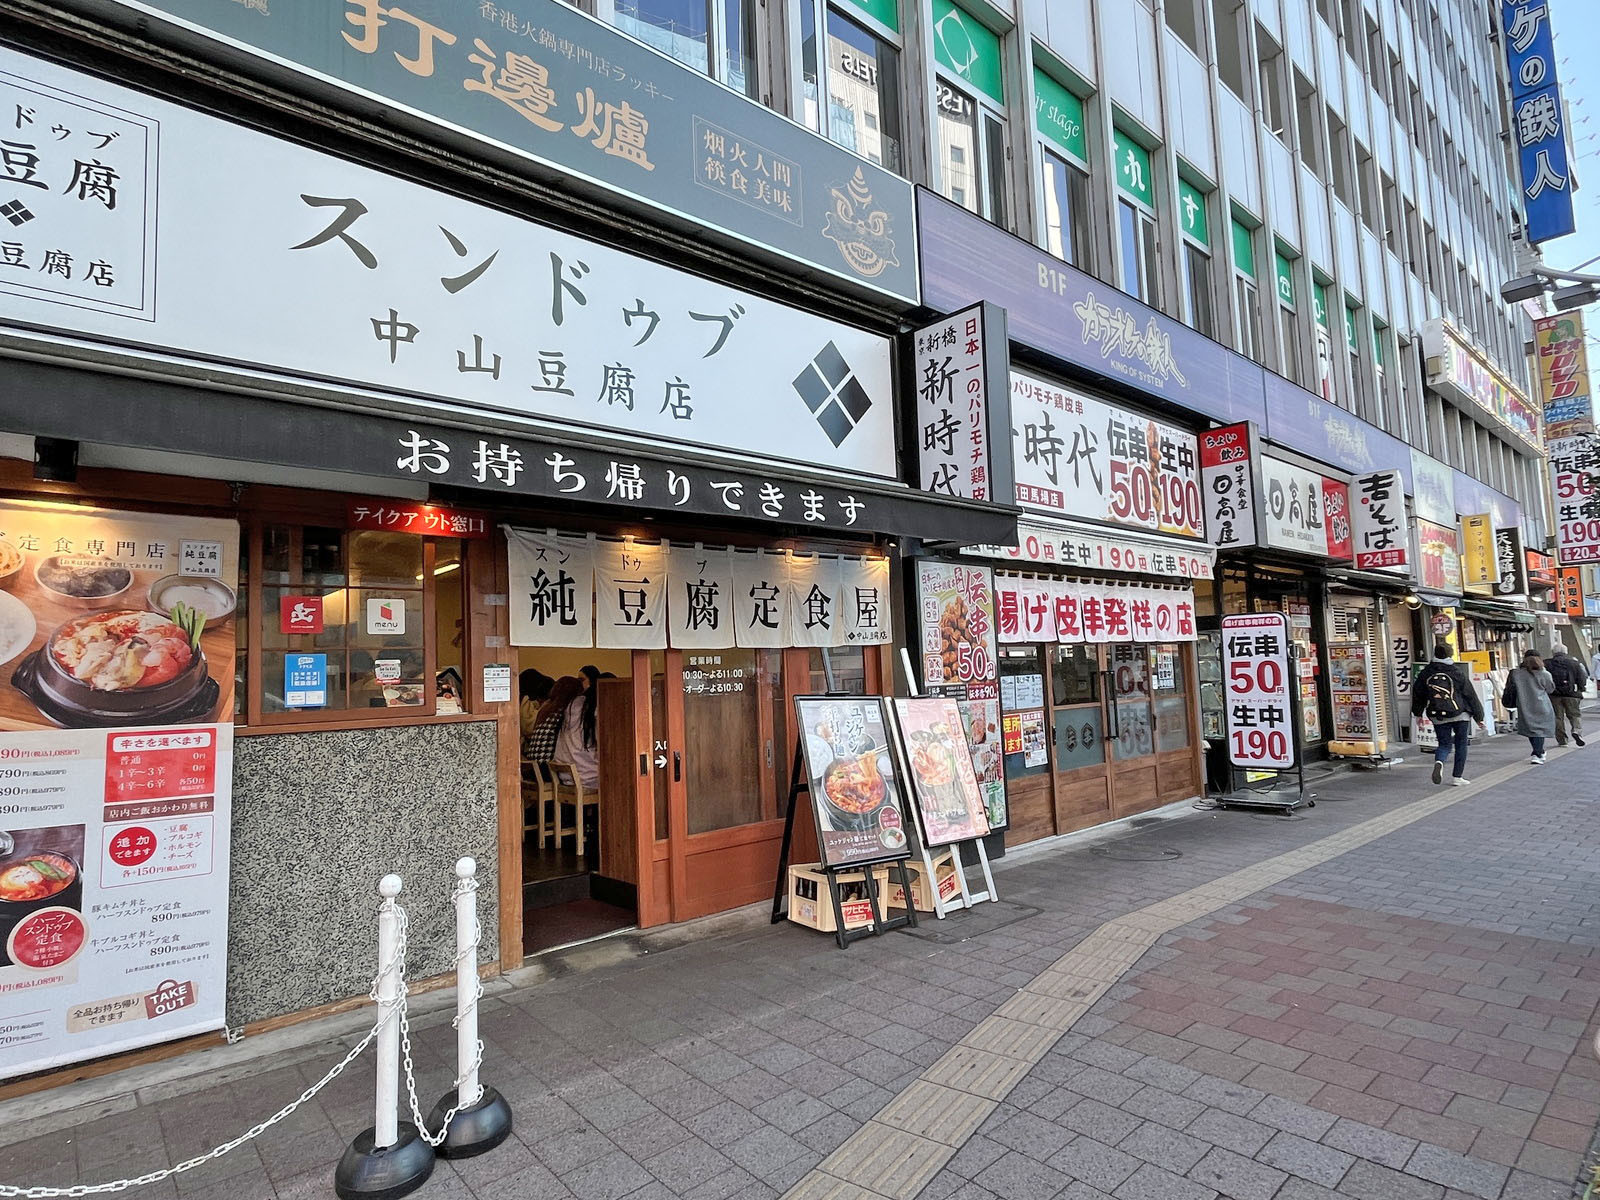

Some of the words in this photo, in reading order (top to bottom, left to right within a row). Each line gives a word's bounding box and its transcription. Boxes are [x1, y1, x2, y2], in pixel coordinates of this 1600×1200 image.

[479, 1, 674, 101] 香港火鍋専門店ラッキー
[1508, 0, 1566, 200] ケの鉄人
[16, 104, 120, 149] ドゥブ
[1048, 105, 1079, 140] stage
[0, 140, 120, 210] 豆腐
[0, 241, 114, 288] 豆腐店
[289, 193, 746, 359] スンドゥブ
[1037, 262, 1067, 297] B1F
[926, 325, 957, 352] 新橋
[370, 308, 694, 421] 中山豆腐店
[1110, 359, 1129, 375] KING
[1130, 366, 1138, 378] OF
[1139, 370, 1164, 388] SYSTEM
[919, 356, 962, 498] 新時代
[1013, 410, 1103, 495] 時代
[1107, 417, 1148, 464] 伝串
[1205, 433, 1237, 448] ちょい
[1221, 446, 1245, 461] 飲み
[1160, 435, 1194, 477] 生中
[396, 430, 866, 527] お持ち帰りできます
[1213, 474, 1240, 546] 日高屋
[1268, 477, 1322, 530] 日高屋
[1359, 474, 1399, 549] 吉そば
[353, 507, 484, 533] テイクアウト窓口
[0, 532, 166, 559] 定食専門店
[1363, 553, 1383, 567] 24
[529, 567, 878, 630] 純豆腐定食屋
[996, 591, 1193, 638] 揚げ皮串発祥の店
[1228, 635, 1279, 658] 伝串
[689, 656, 721, 665] 営業時間
[1393, 637, 1411, 694] カラオケ
[682, 683, 743, 694] オーダーよる10:30
[1230, 661, 1284, 694] 50円
[1342, 678, 1363, 687] 264
[1232, 705, 1284, 728] 生中
[1345, 725, 1368, 734] 602
[120, 736, 204, 749] 辛さを選べます
[655, 740, 667, 750] 入
[120, 755, 141, 765] 普通
[109, 801, 209, 818] 店内ご飯おかわり無料
[115, 848, 151, 858] できます
[116, 835, 150, 848] 追加
[24, 919, 74, 936] スンドゥブ
[33, 913, 66, 925] ハーフ
[35, 932, 63, 946] 定食
[0, 975, 64, 992] 円(税込1,089円)
[150, 985, 188, 1005] TAKE
[72, 997, 140, 1018] 全品お持ち帰り
[89, 1010, 125, 1025] できます
[155, 996, 187, 1015] OUT
